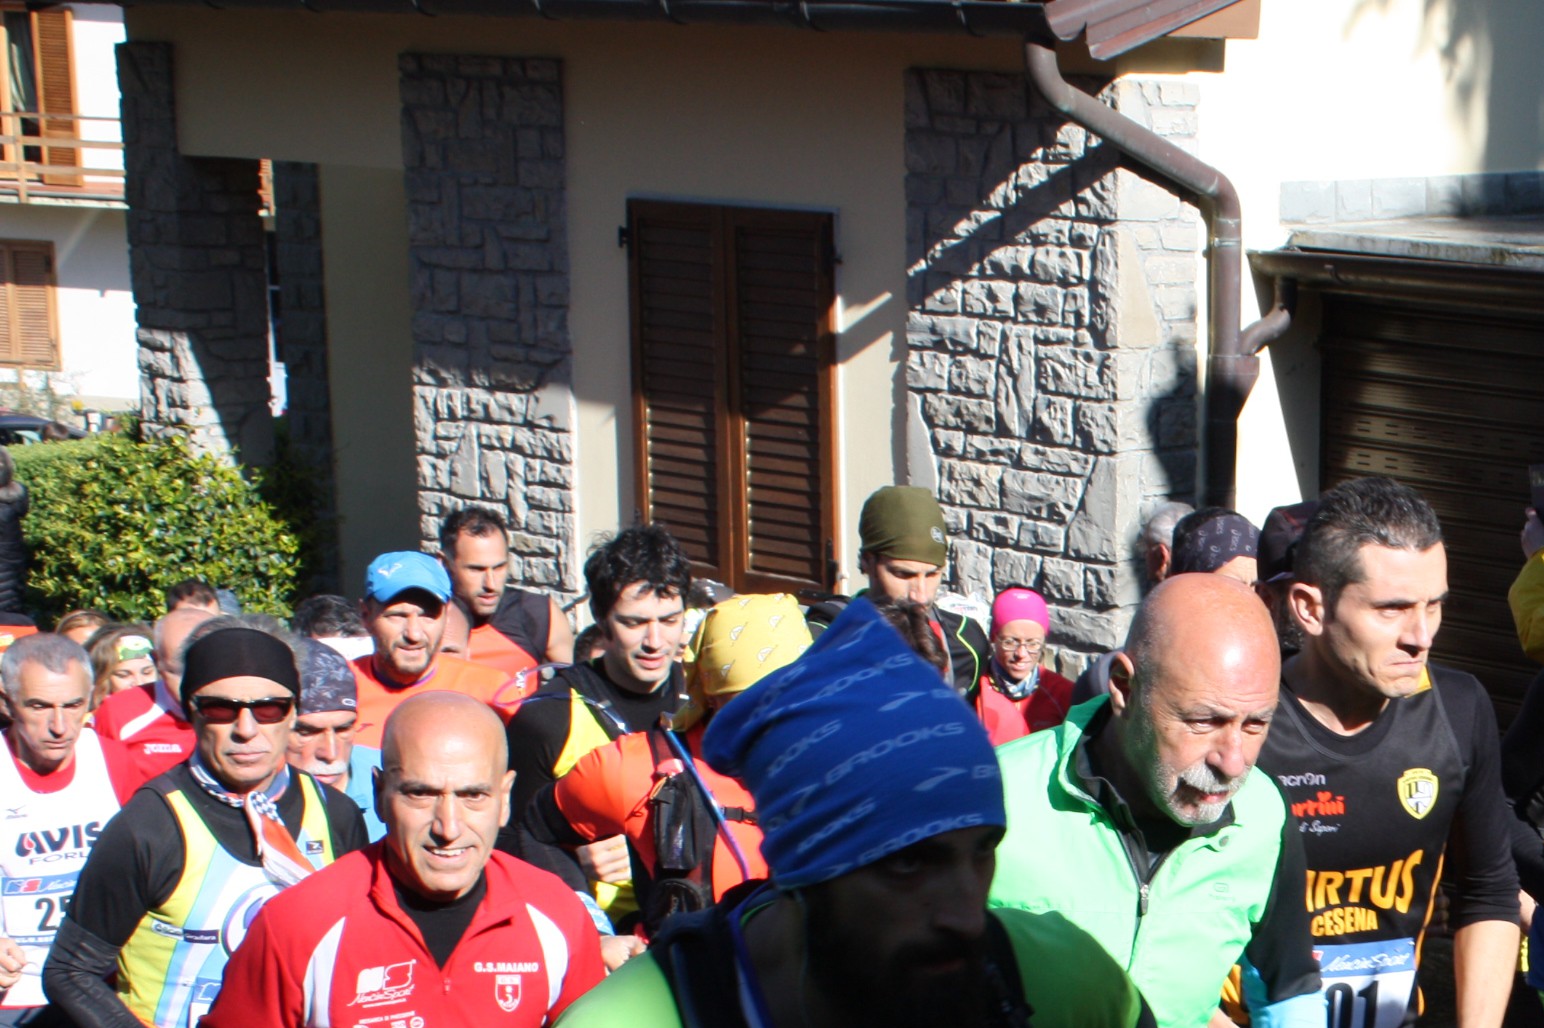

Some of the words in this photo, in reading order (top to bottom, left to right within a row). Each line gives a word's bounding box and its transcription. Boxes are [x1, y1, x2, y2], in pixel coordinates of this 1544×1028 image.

[825, 721, 966, 787] BROOKS
[15, 821, 100, 857] AVIS
[857, 812, 985, 865] BROOKS
[1310, 906, 1379, 937] CESENA
